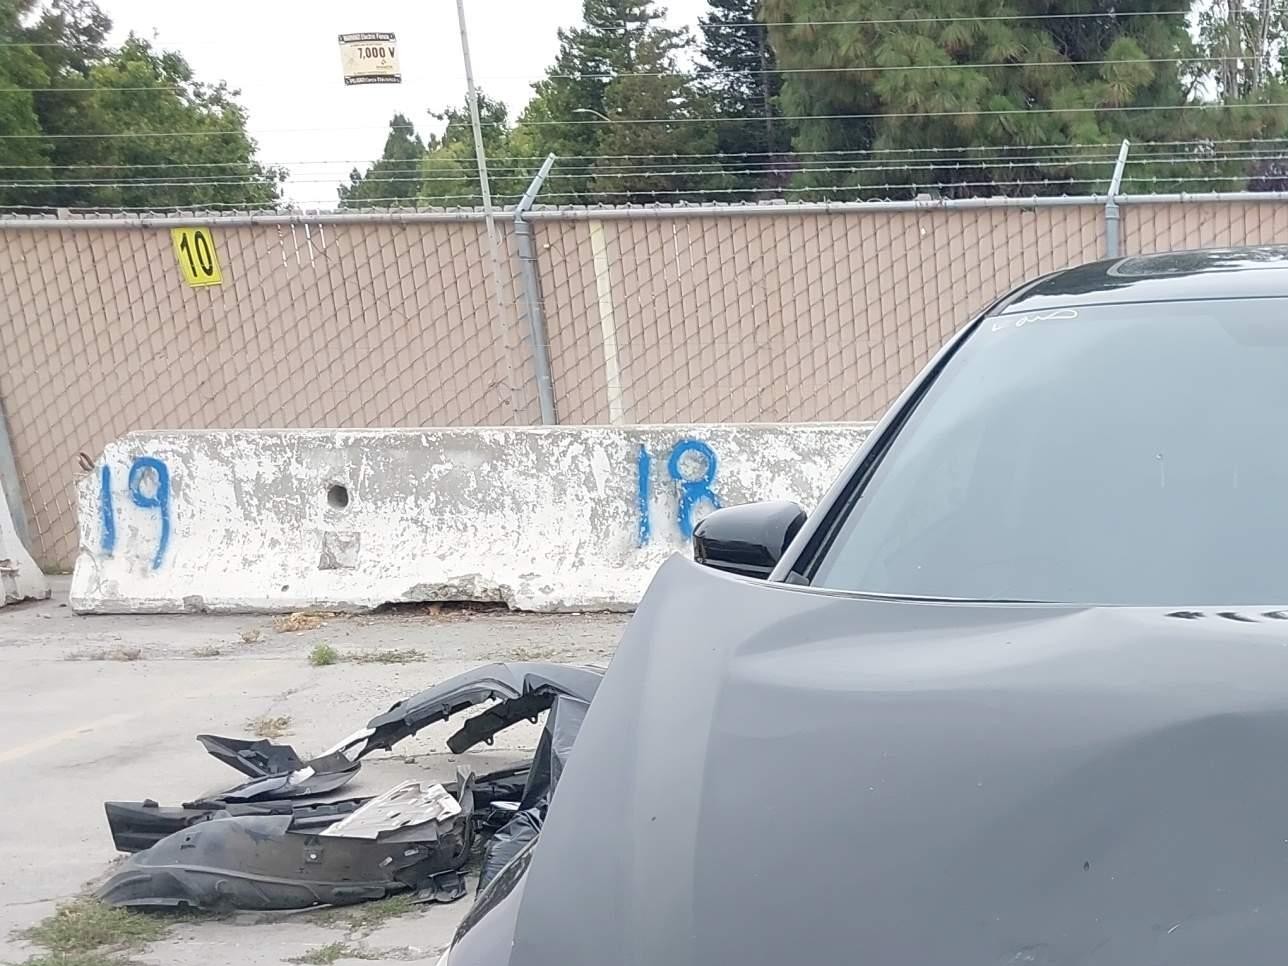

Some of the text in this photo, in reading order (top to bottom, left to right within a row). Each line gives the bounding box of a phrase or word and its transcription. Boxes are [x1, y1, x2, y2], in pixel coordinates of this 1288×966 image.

[357, 47, 395, 60] 7,000 V
[180, 230, 213, 278] 10
[100, 456, 170, 571] 19
[636, 437, 722, 549] 18
